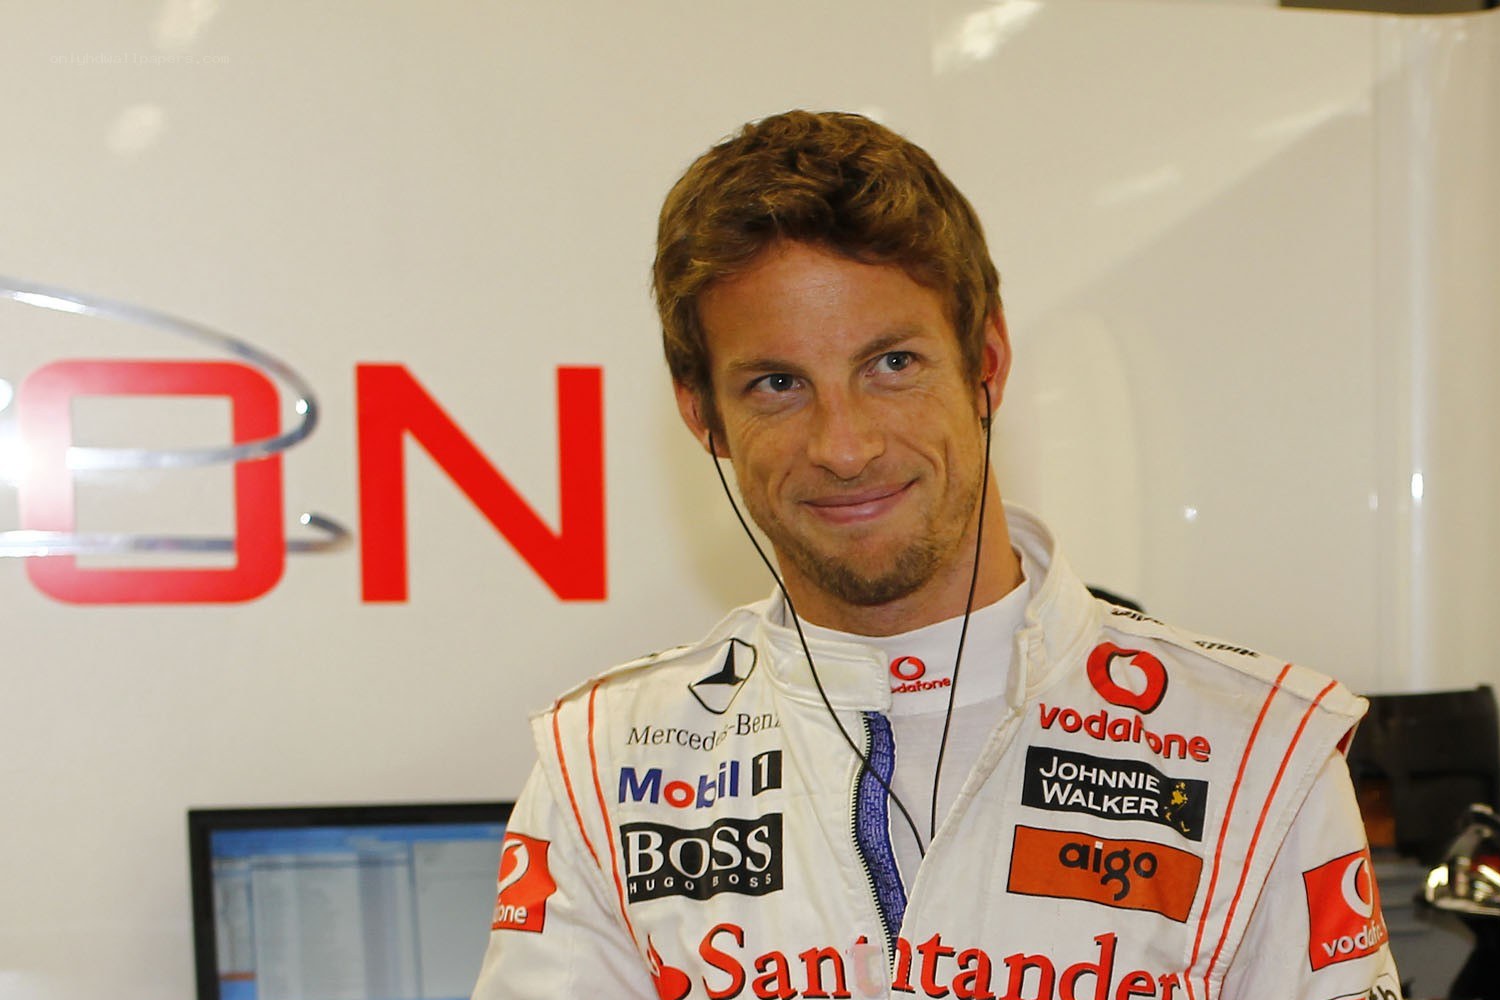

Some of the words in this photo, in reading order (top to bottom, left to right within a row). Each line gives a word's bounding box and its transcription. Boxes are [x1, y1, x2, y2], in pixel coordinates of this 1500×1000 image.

[1039, 703, 1212, 762] vodafone
[618, 760, 740, 810] Mobil
[1039, 756, 1161, 794] JOHNNIE
[1042, 779, 1160, 818] WALKER
[626, 825, 772, 879] BOSS
[1058, 840, 1159, 901] aigo
[629, 875, 696, 895] HUGO
[712, 871, 773, 888] BOSS
